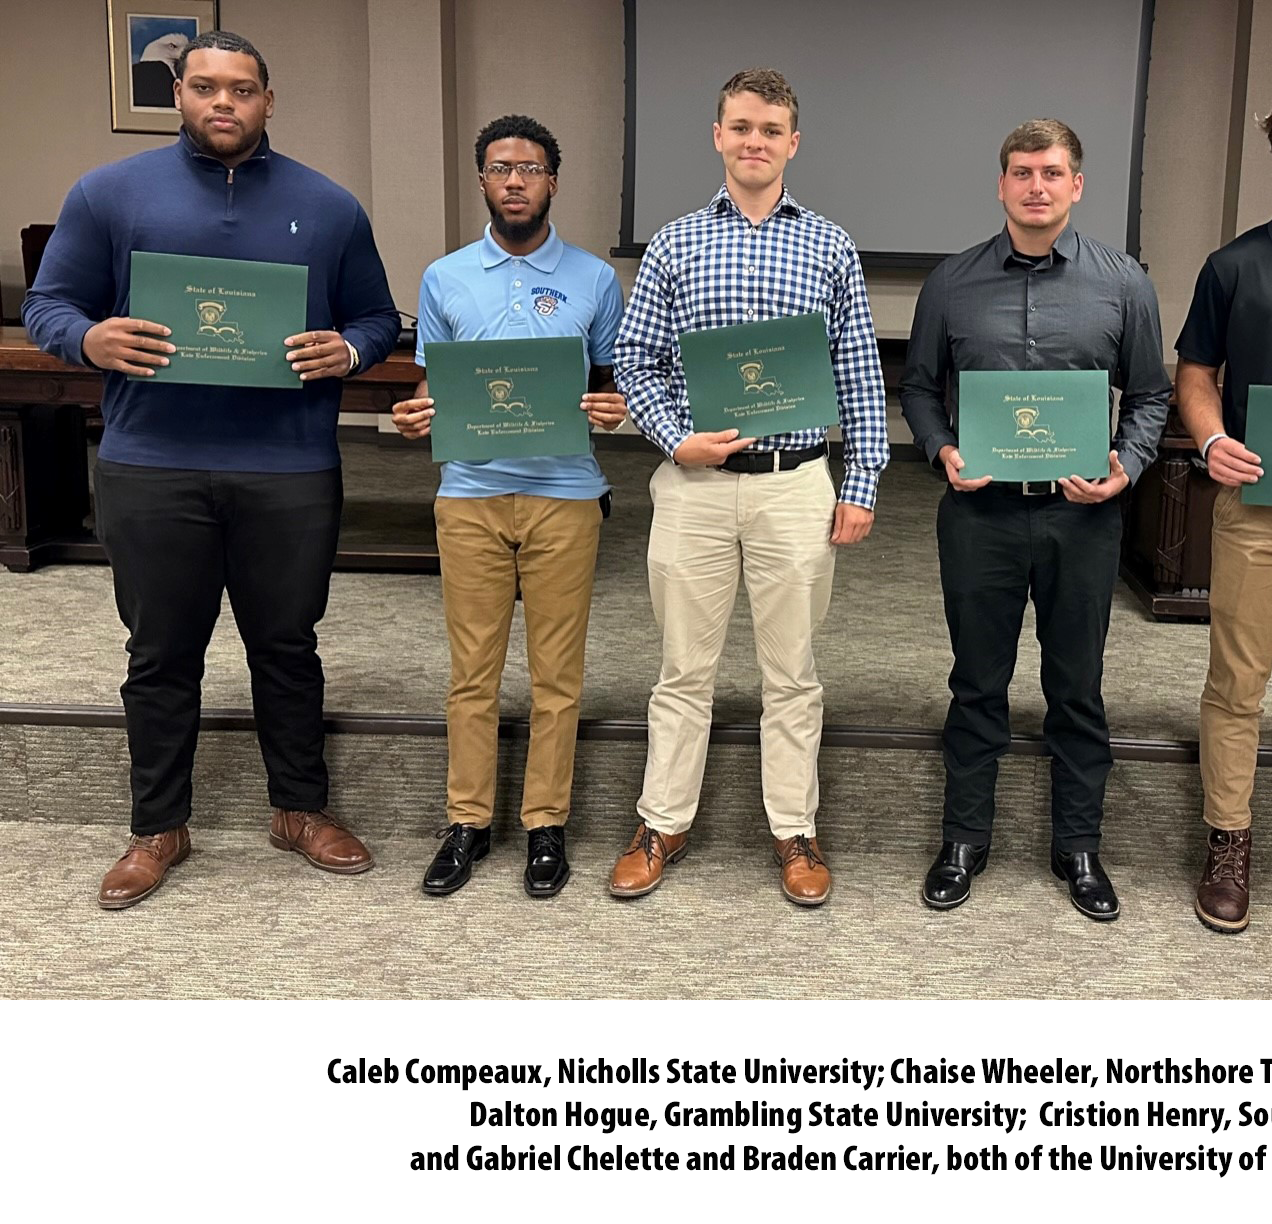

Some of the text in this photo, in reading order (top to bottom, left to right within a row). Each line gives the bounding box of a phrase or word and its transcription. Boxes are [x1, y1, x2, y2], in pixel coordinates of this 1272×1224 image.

[184, 285, 205, 293] State
[218, 288, 256, 297] Louisiana
[531, 286, 567, 303] SOUTHERN
[727, 352, 743, 360] State
[753, 346, 785, 355] Louisiana
[1004, 394, 1021, 402] State
